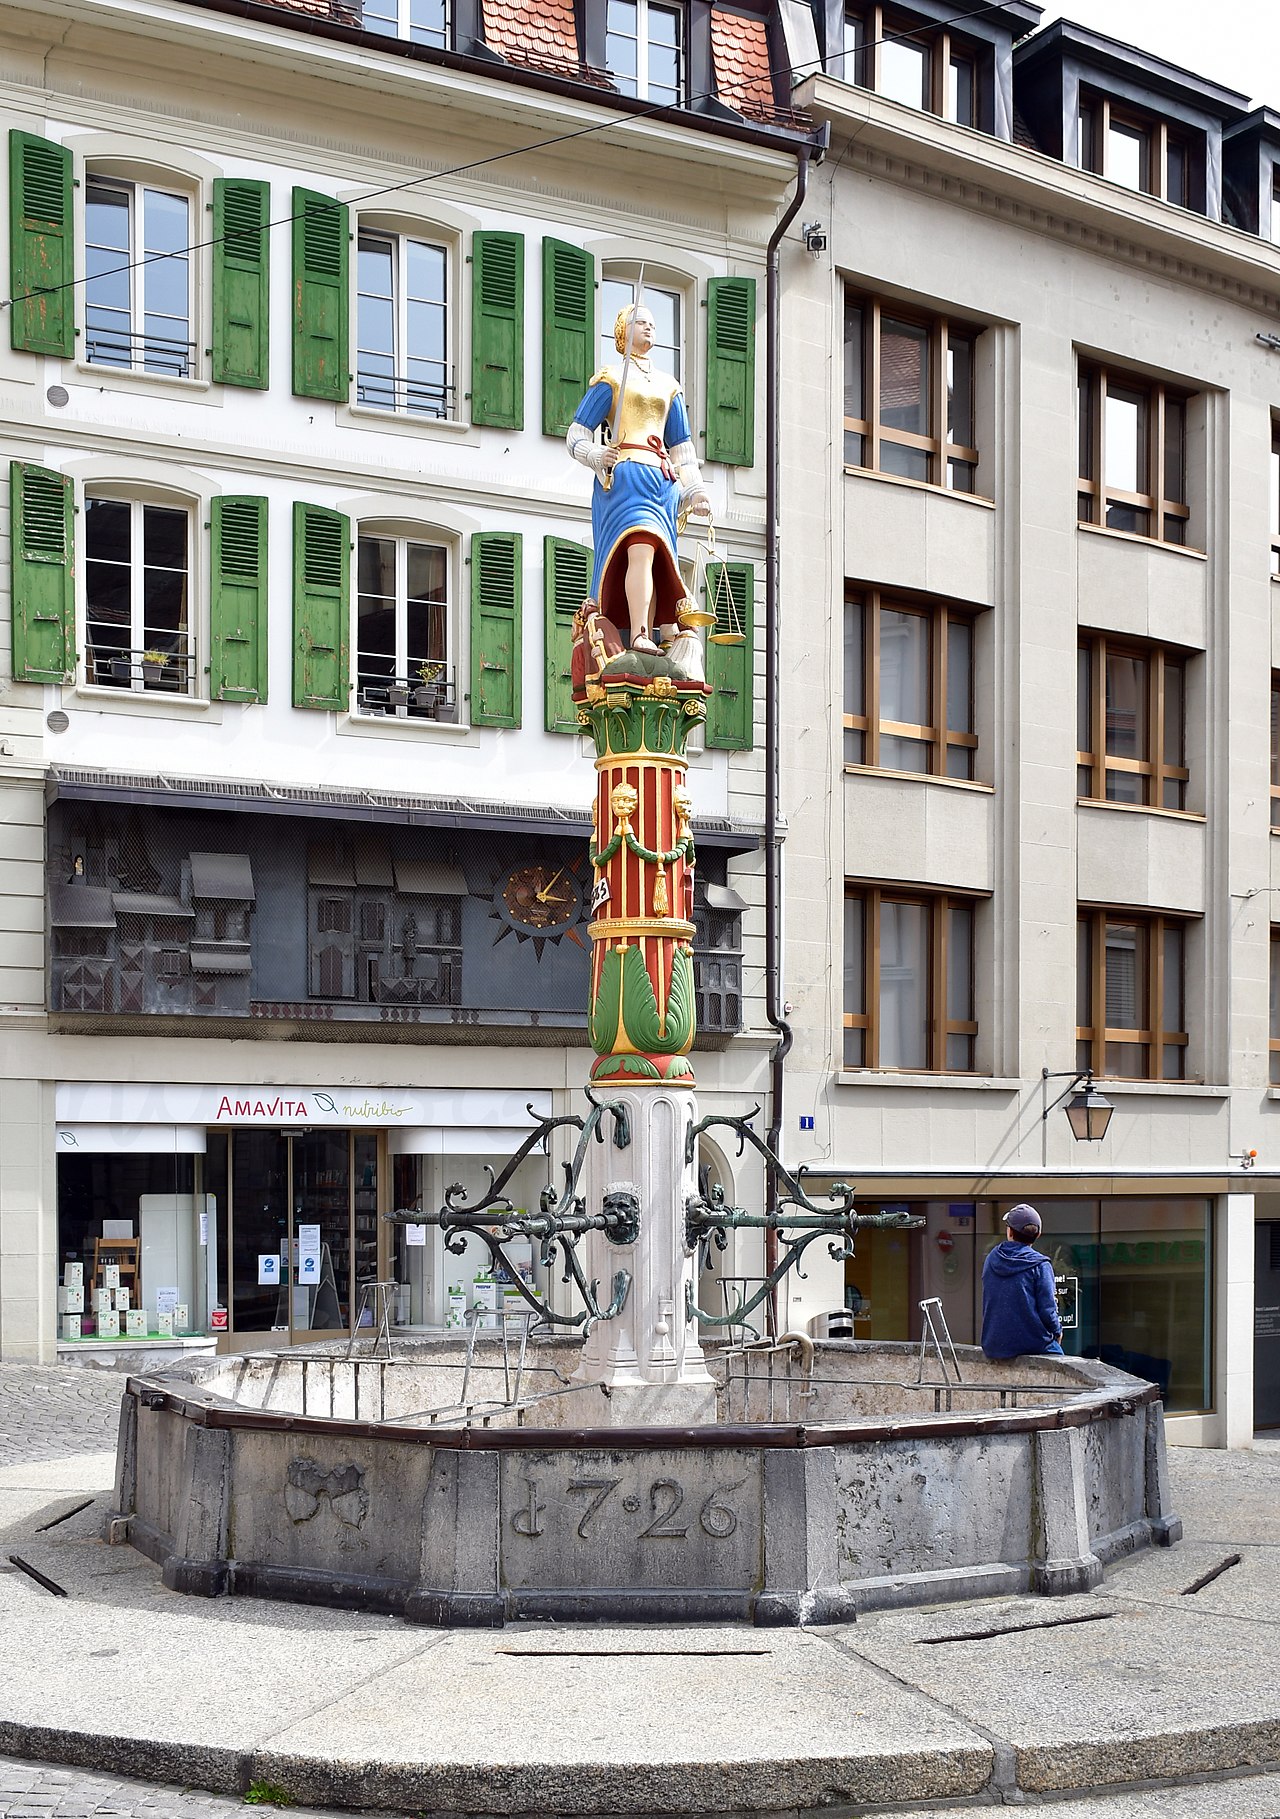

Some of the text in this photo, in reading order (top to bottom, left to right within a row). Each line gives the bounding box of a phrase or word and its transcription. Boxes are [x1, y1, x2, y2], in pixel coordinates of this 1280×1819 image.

[216, 1096, 308, 1120] AMAVITA
[343, 1099, 414, 1119] nutribio
[1063, 1314, 1074, 1323] up!
